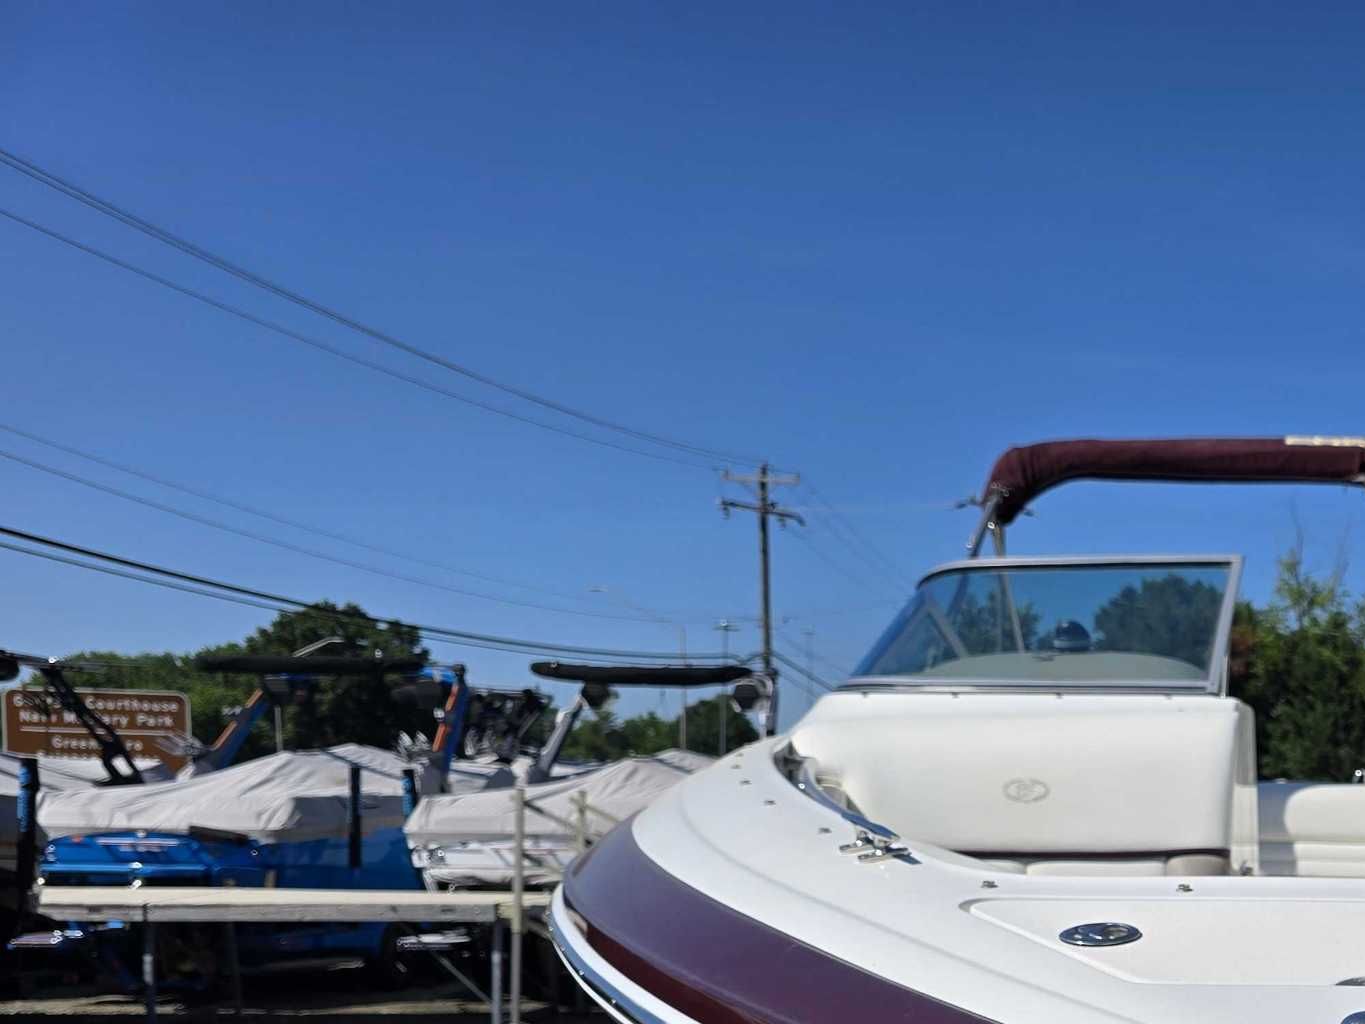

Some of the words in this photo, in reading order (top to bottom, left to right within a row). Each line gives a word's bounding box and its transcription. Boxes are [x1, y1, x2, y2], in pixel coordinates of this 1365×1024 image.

[84, 695, 179, 712] Courthouse
[136, 714, 175, 727] Park
[51, 734, 144, 751] Greenro
